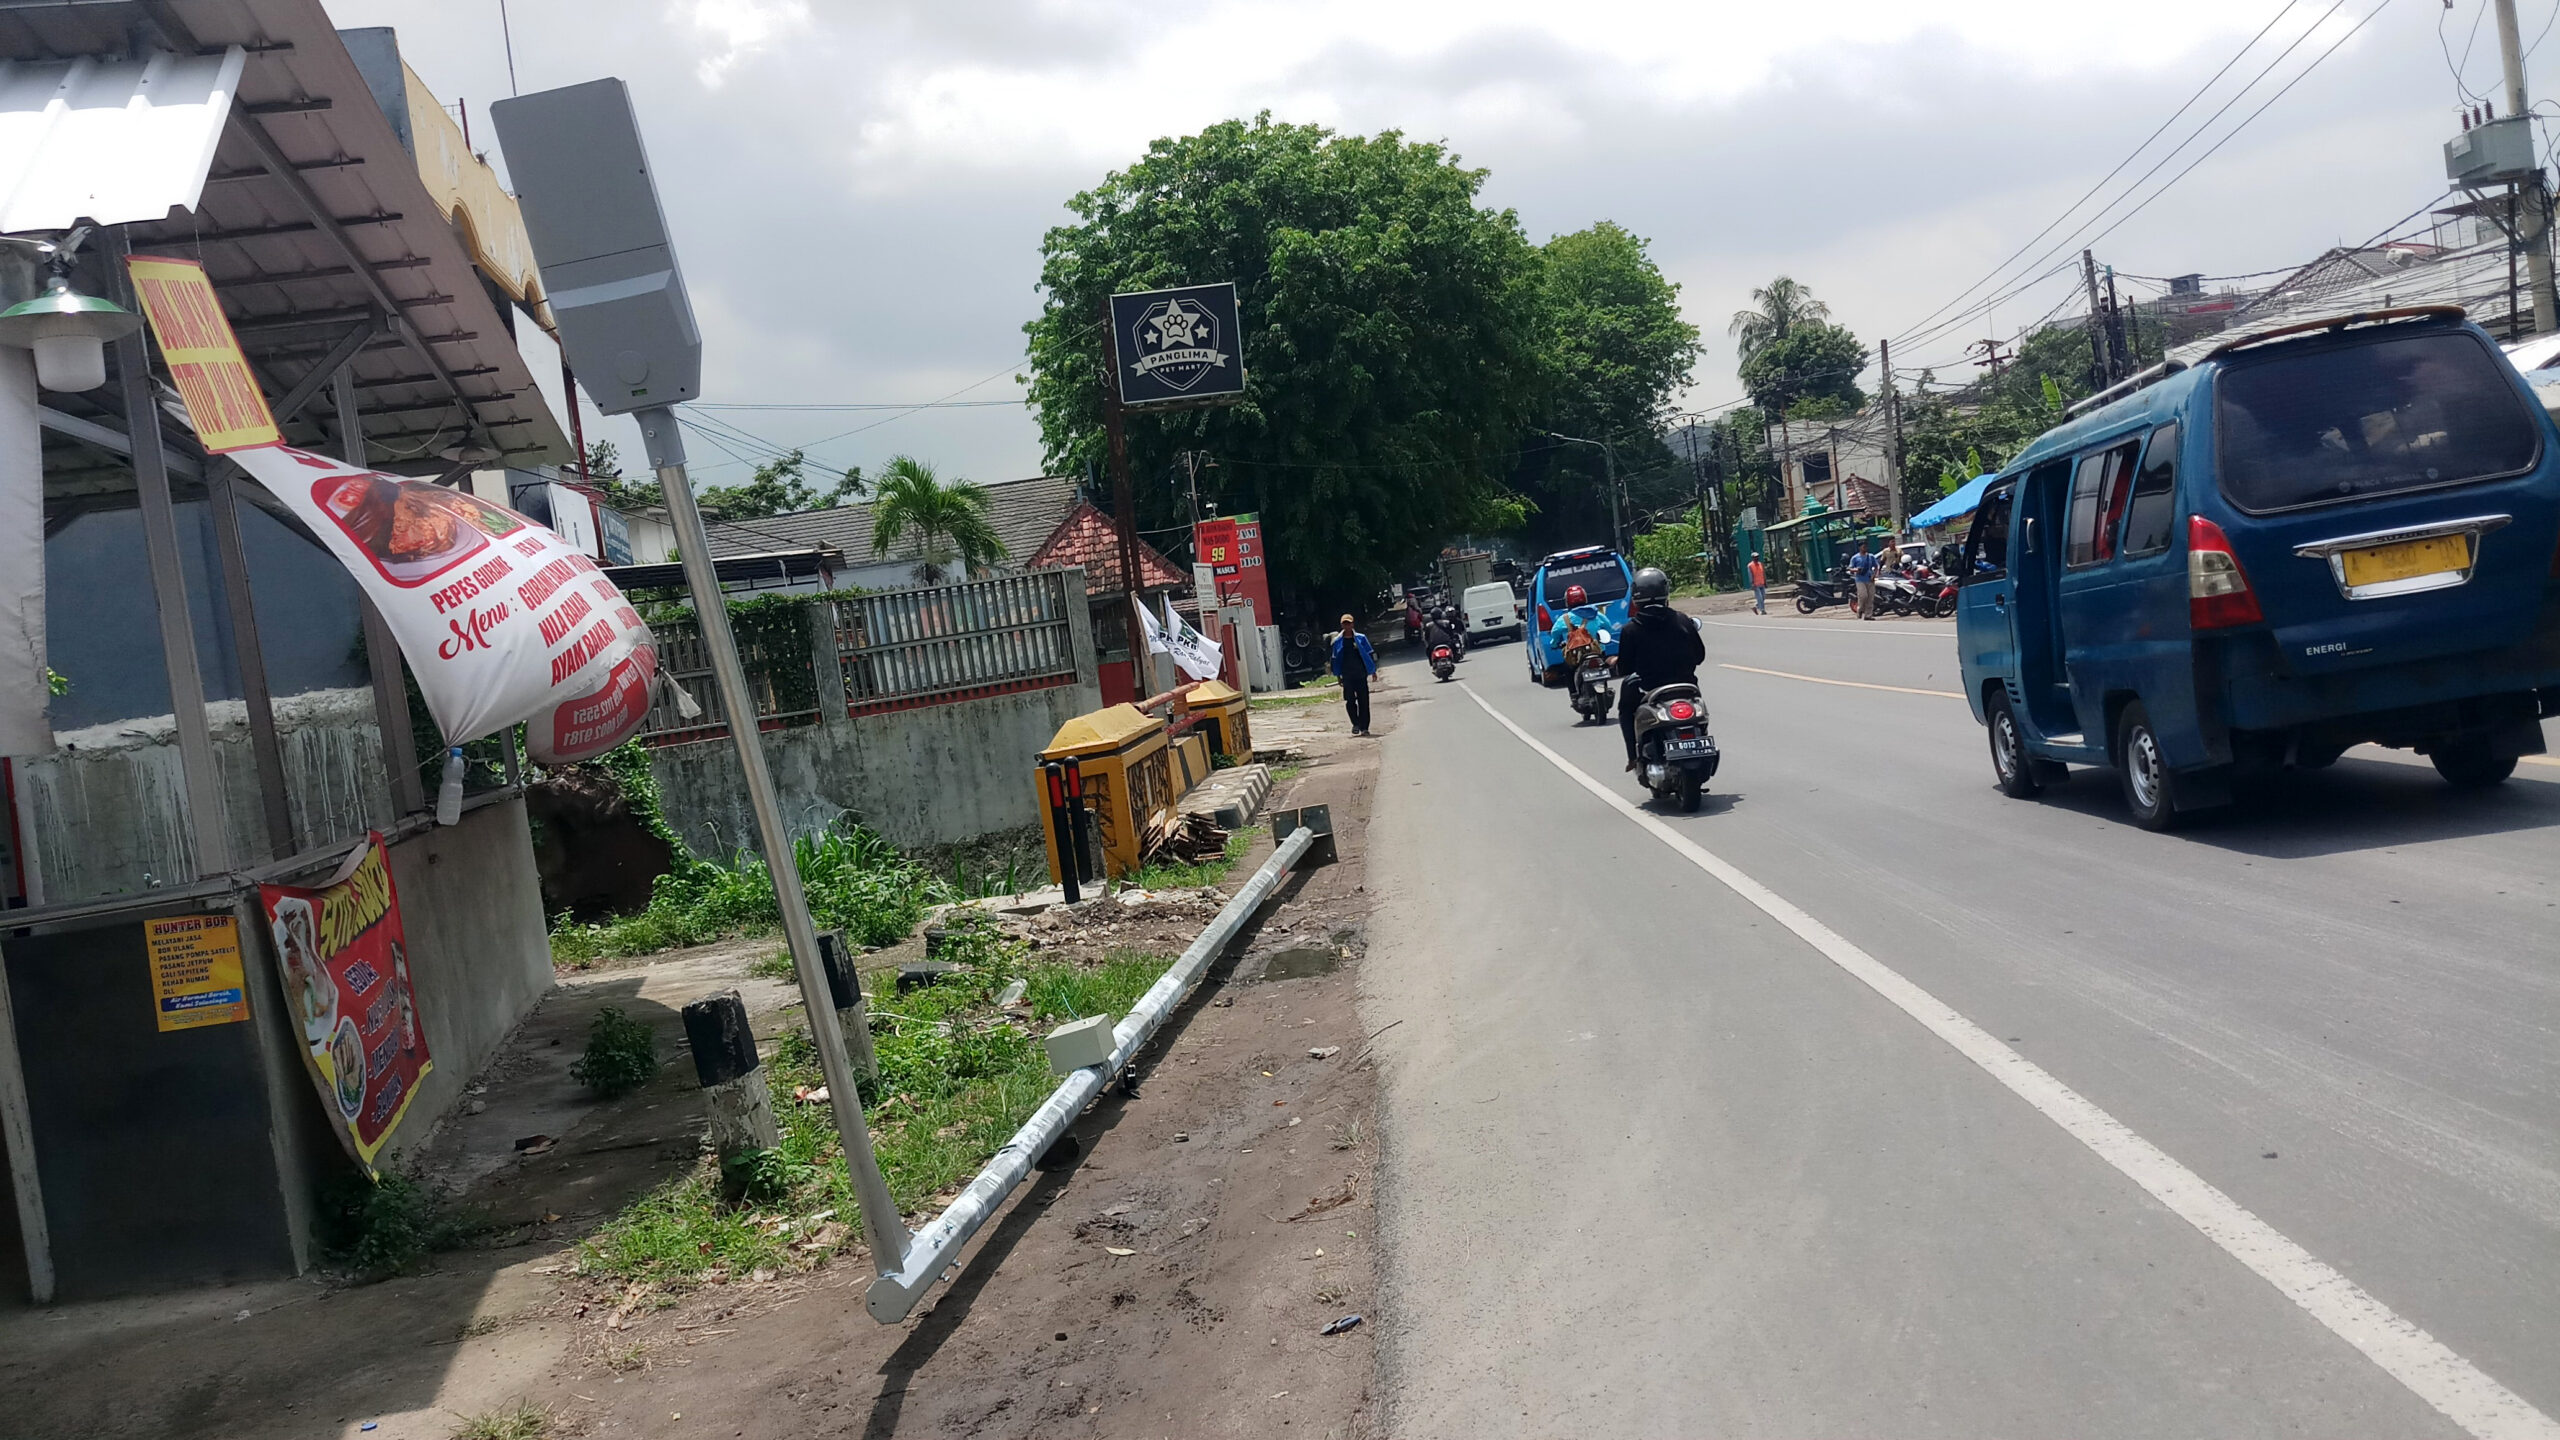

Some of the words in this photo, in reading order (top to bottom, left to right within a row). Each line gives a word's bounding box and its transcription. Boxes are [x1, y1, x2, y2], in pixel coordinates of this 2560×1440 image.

[1150, 351, 1209, 365] PANGLIMA
[1160, 366, 1175, 374] PET
[1178, 363, 1201, 372] MART
[171, 363, 225, 435] TUTUP
[1211, 546, 1225, 562] 99
[430, 575, 480, 615] PEPES
[538, 608, 570, 649] NILA
[560, 591, 592, 628] BAKAR
[438, 602, 509, 660] Menu
[1159, 631, 1174, 643] PK
[1177, 635, 1198, 650] PKB
[2306, 642, 2347, 656] ENERGI
[551, 639, 587, 688] AYAM
[581, 618, 616, 660] BAKAR
[153, 919, 202, 935] HUNTER
[204, 916, 229, 929] BOR
[152, 937, 184, 946] MELAYANI
[186, 934, 202, 942] JASA
[158, 946, 171, 954] BOR
[173, 944, 194, 952] ULANG
[159, 954, 184, 962] PASANG
[186, 950, 209, 959] POMPA
[211, 946, 236, 954] SATELIT
[160, 962, 185, 970] PASANG
